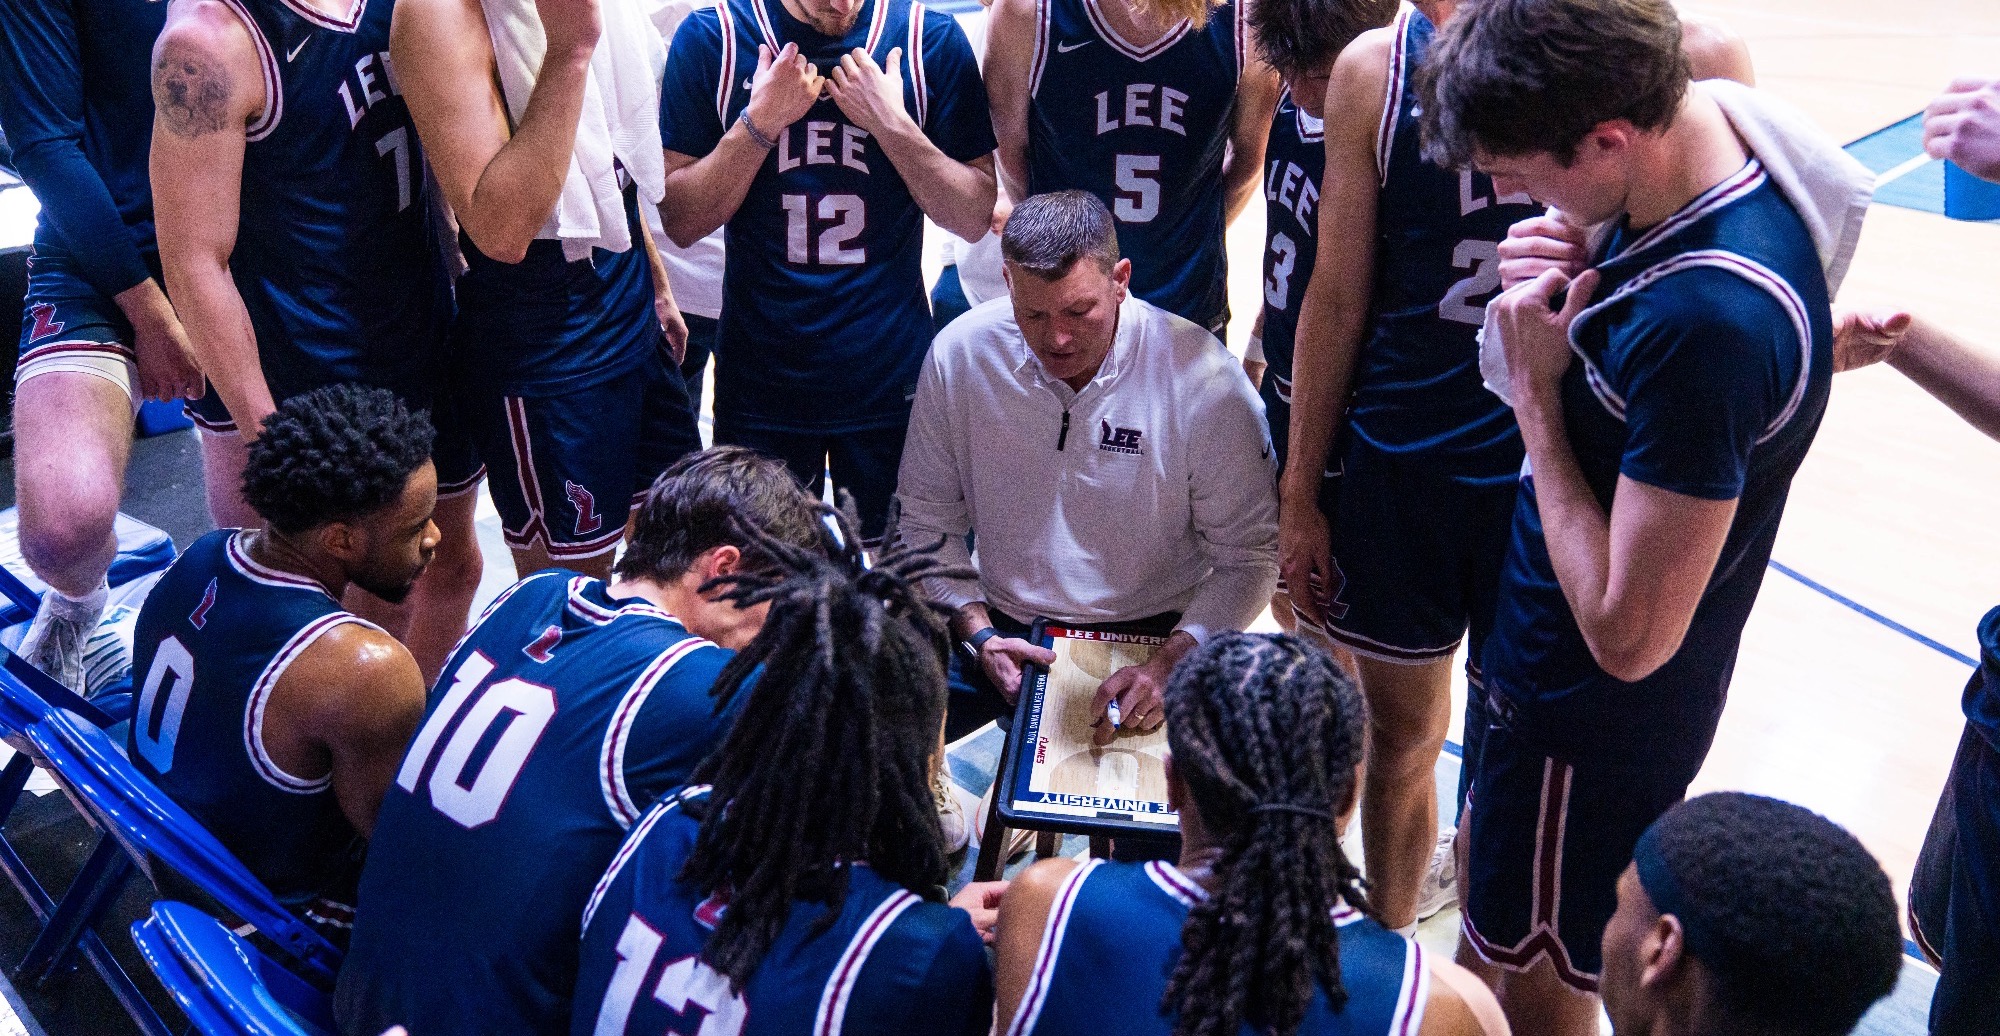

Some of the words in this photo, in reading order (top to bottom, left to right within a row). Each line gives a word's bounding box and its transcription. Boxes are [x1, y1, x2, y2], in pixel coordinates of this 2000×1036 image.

[1094, 83, 1190, 137] LEE
[375, 126, 411, 212] 7
[778, 121, 870, 174] LEE
[1113, 153, 1161, 223] 5
[1267, 159, 1320, 238] LEE
[781, 193, 866, 265] 12
[1265, 231, 1297, 311] 3
[1101, 418, 1142, 449] LEE
[1066, 629, 1095, 639] LEE
[135, 635, 195, 775] 0
[396, 648, 558, 830] 10
[1036, 736, 1049, 764] FLAMES
[1039, 793, 1151, 813] UNIVERSITY
